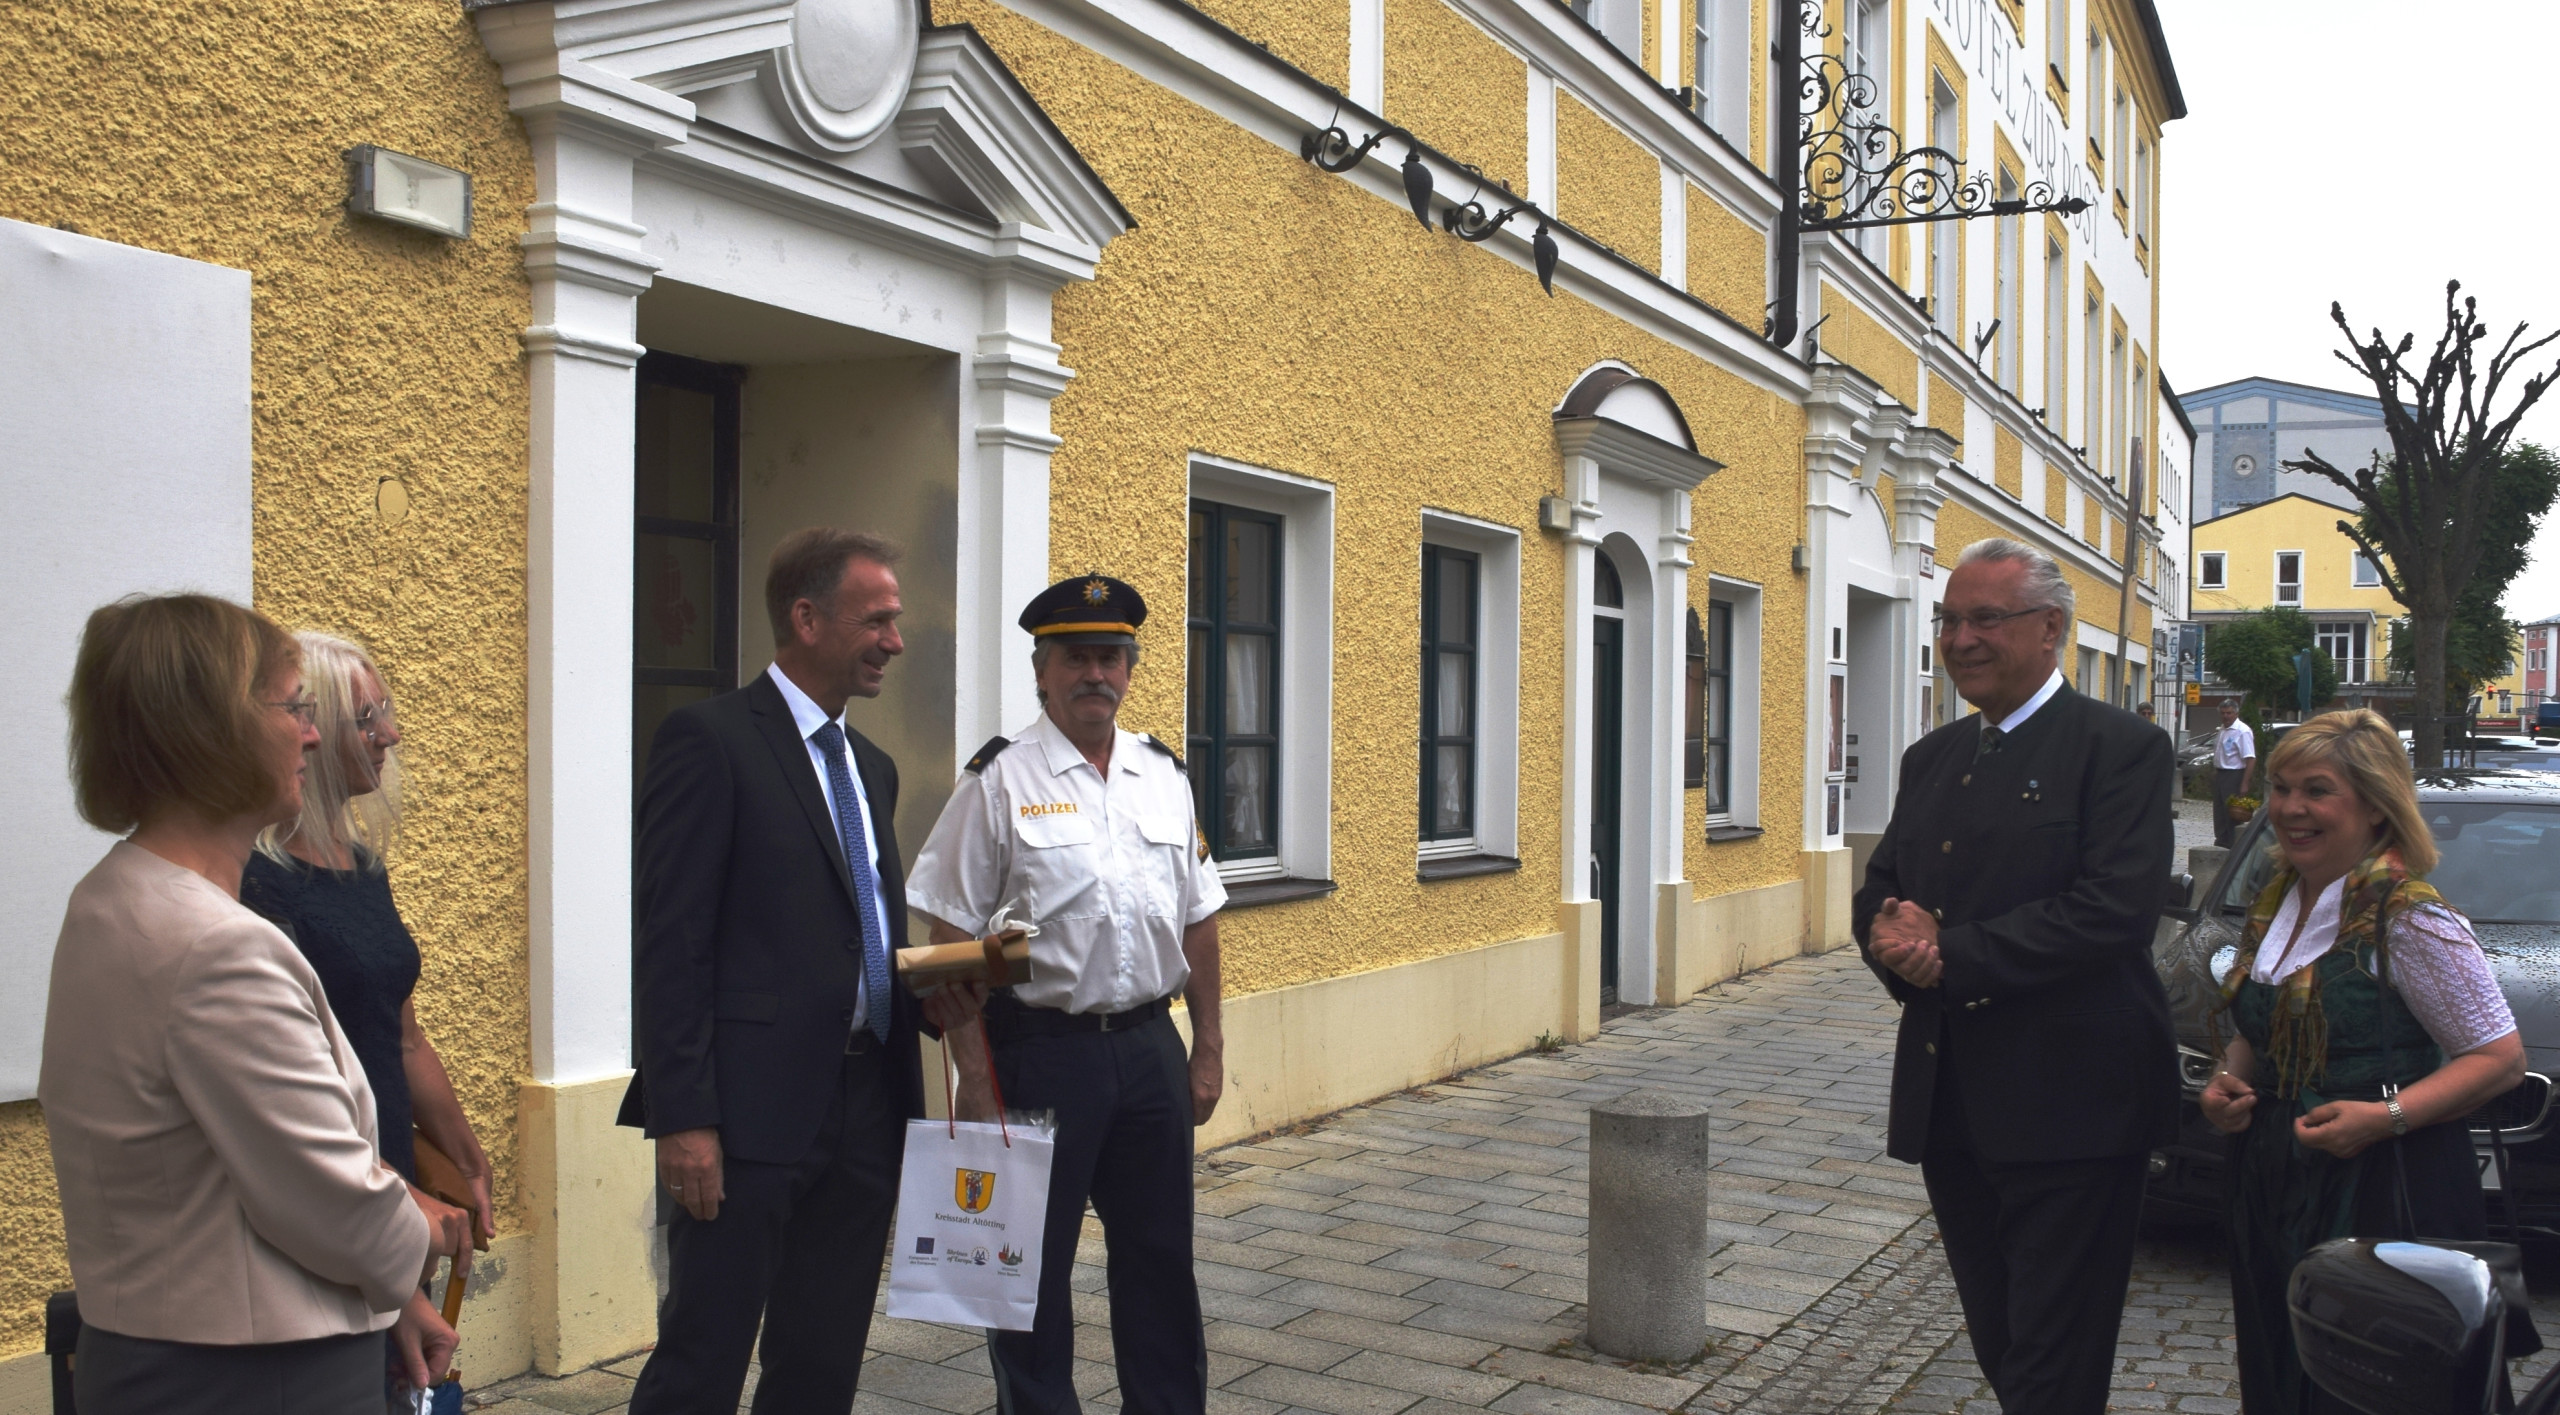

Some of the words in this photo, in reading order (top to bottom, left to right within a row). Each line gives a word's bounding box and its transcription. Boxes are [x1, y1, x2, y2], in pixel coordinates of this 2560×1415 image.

[1934, 0, 2016, 127] OTEL
[2022, 69, 2055, 194] ZUR
[2062, 142, 2099, 258] POST
[2168, 637, 2177, 675] buch
[1020, 803, 1077, 817] POLIZEI
[935, 1212, 970, 1224] Kreisstadt
[973, 1217, 1005, 1230] Altötting
